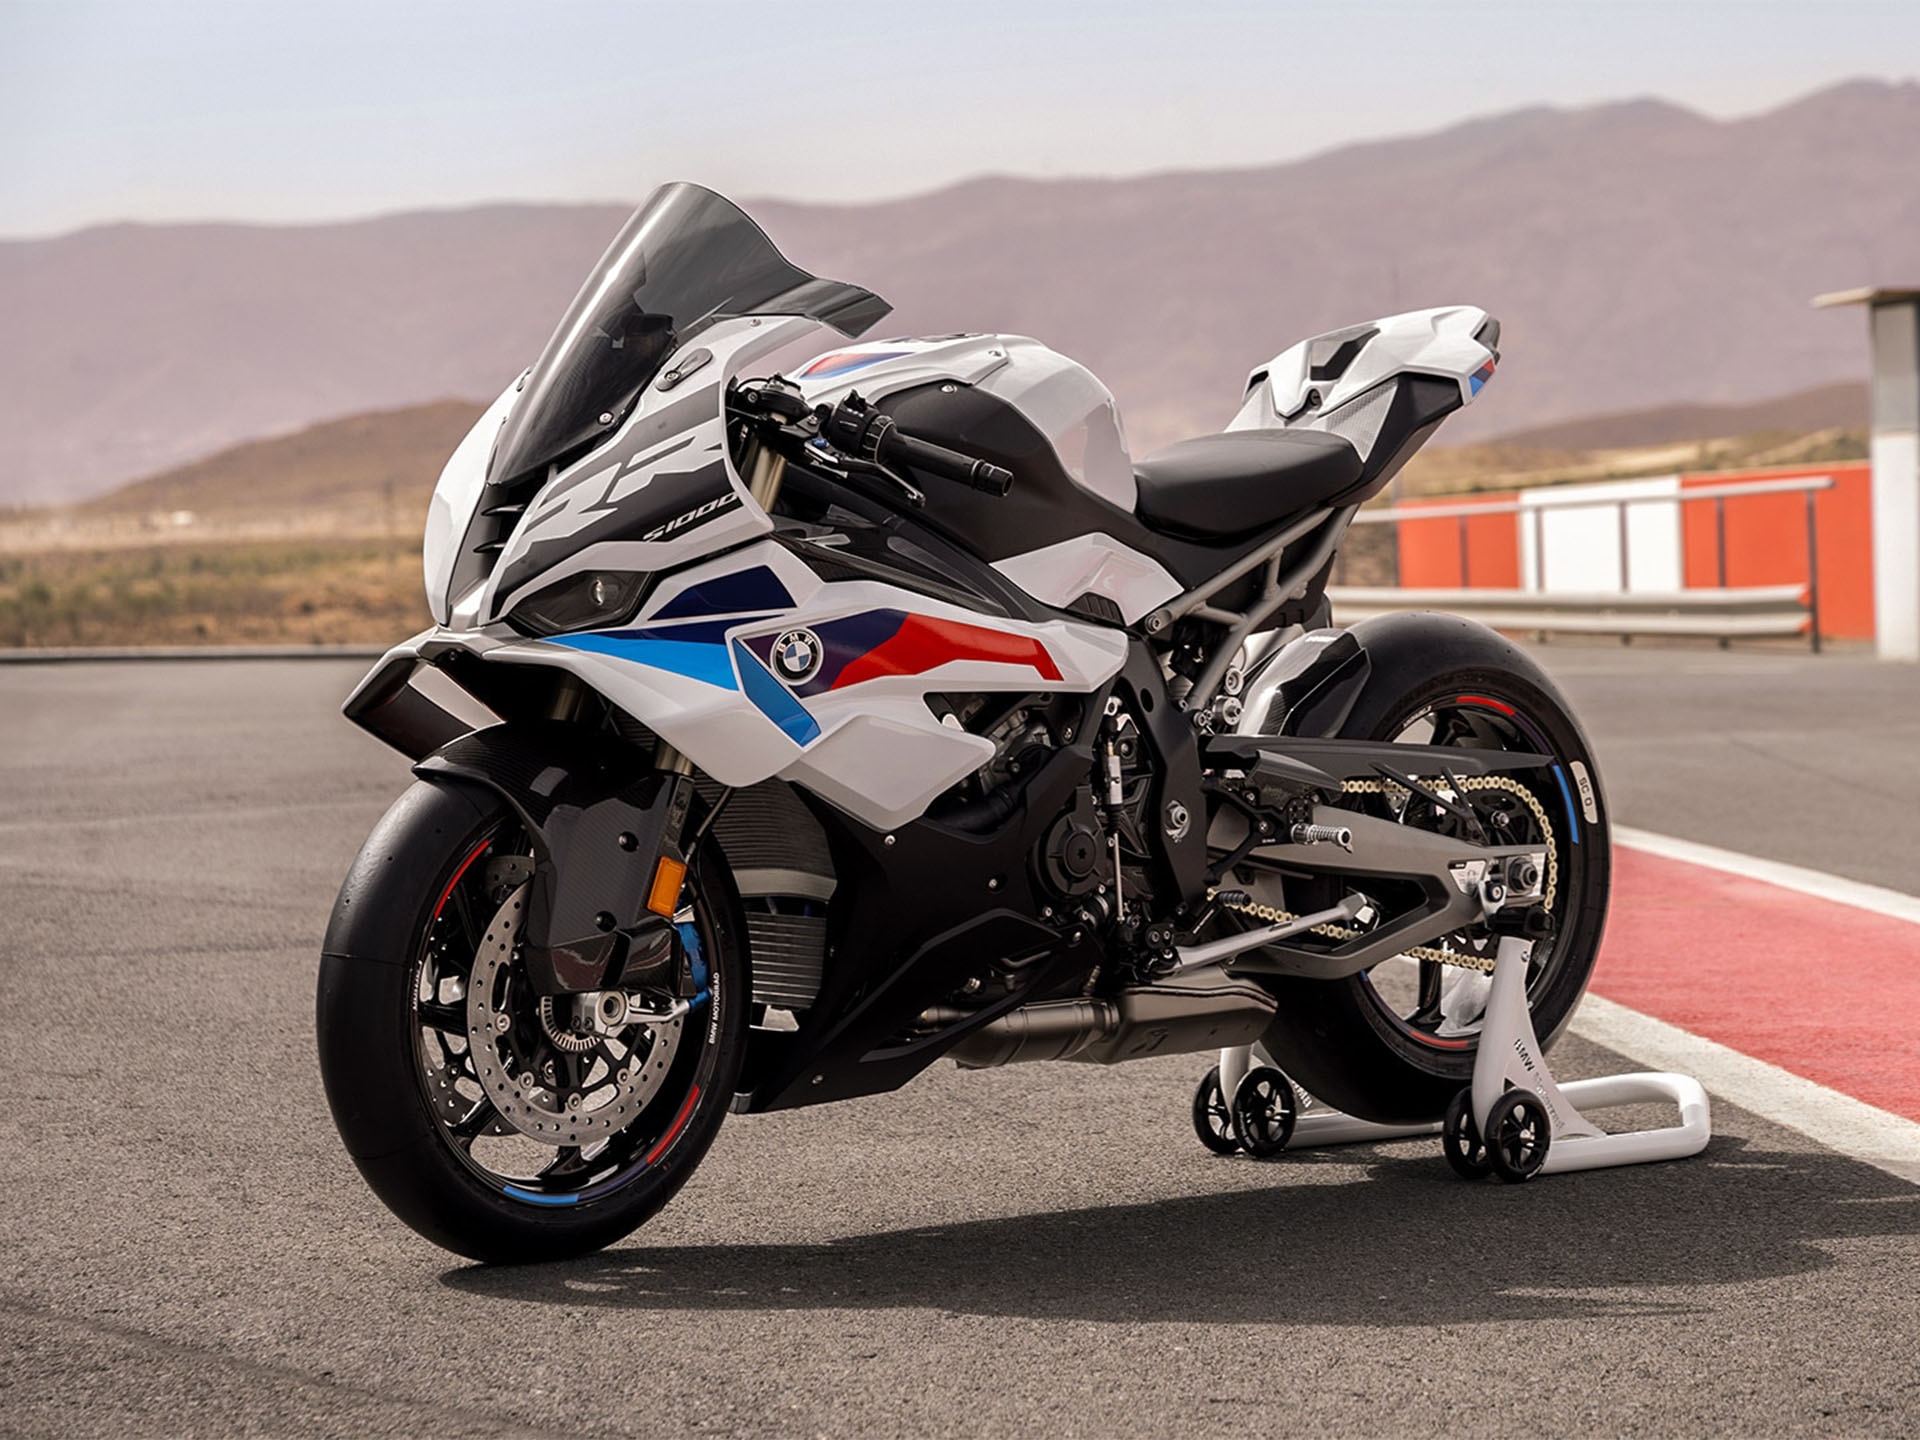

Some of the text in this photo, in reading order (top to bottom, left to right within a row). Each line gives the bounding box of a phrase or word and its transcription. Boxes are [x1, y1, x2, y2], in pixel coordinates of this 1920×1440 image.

[777, 632, 815, 653] BMW
[708, 972, 720, 1044] BMW MOTORRAD
[1513, 1038, 1536, 1072] BMW
